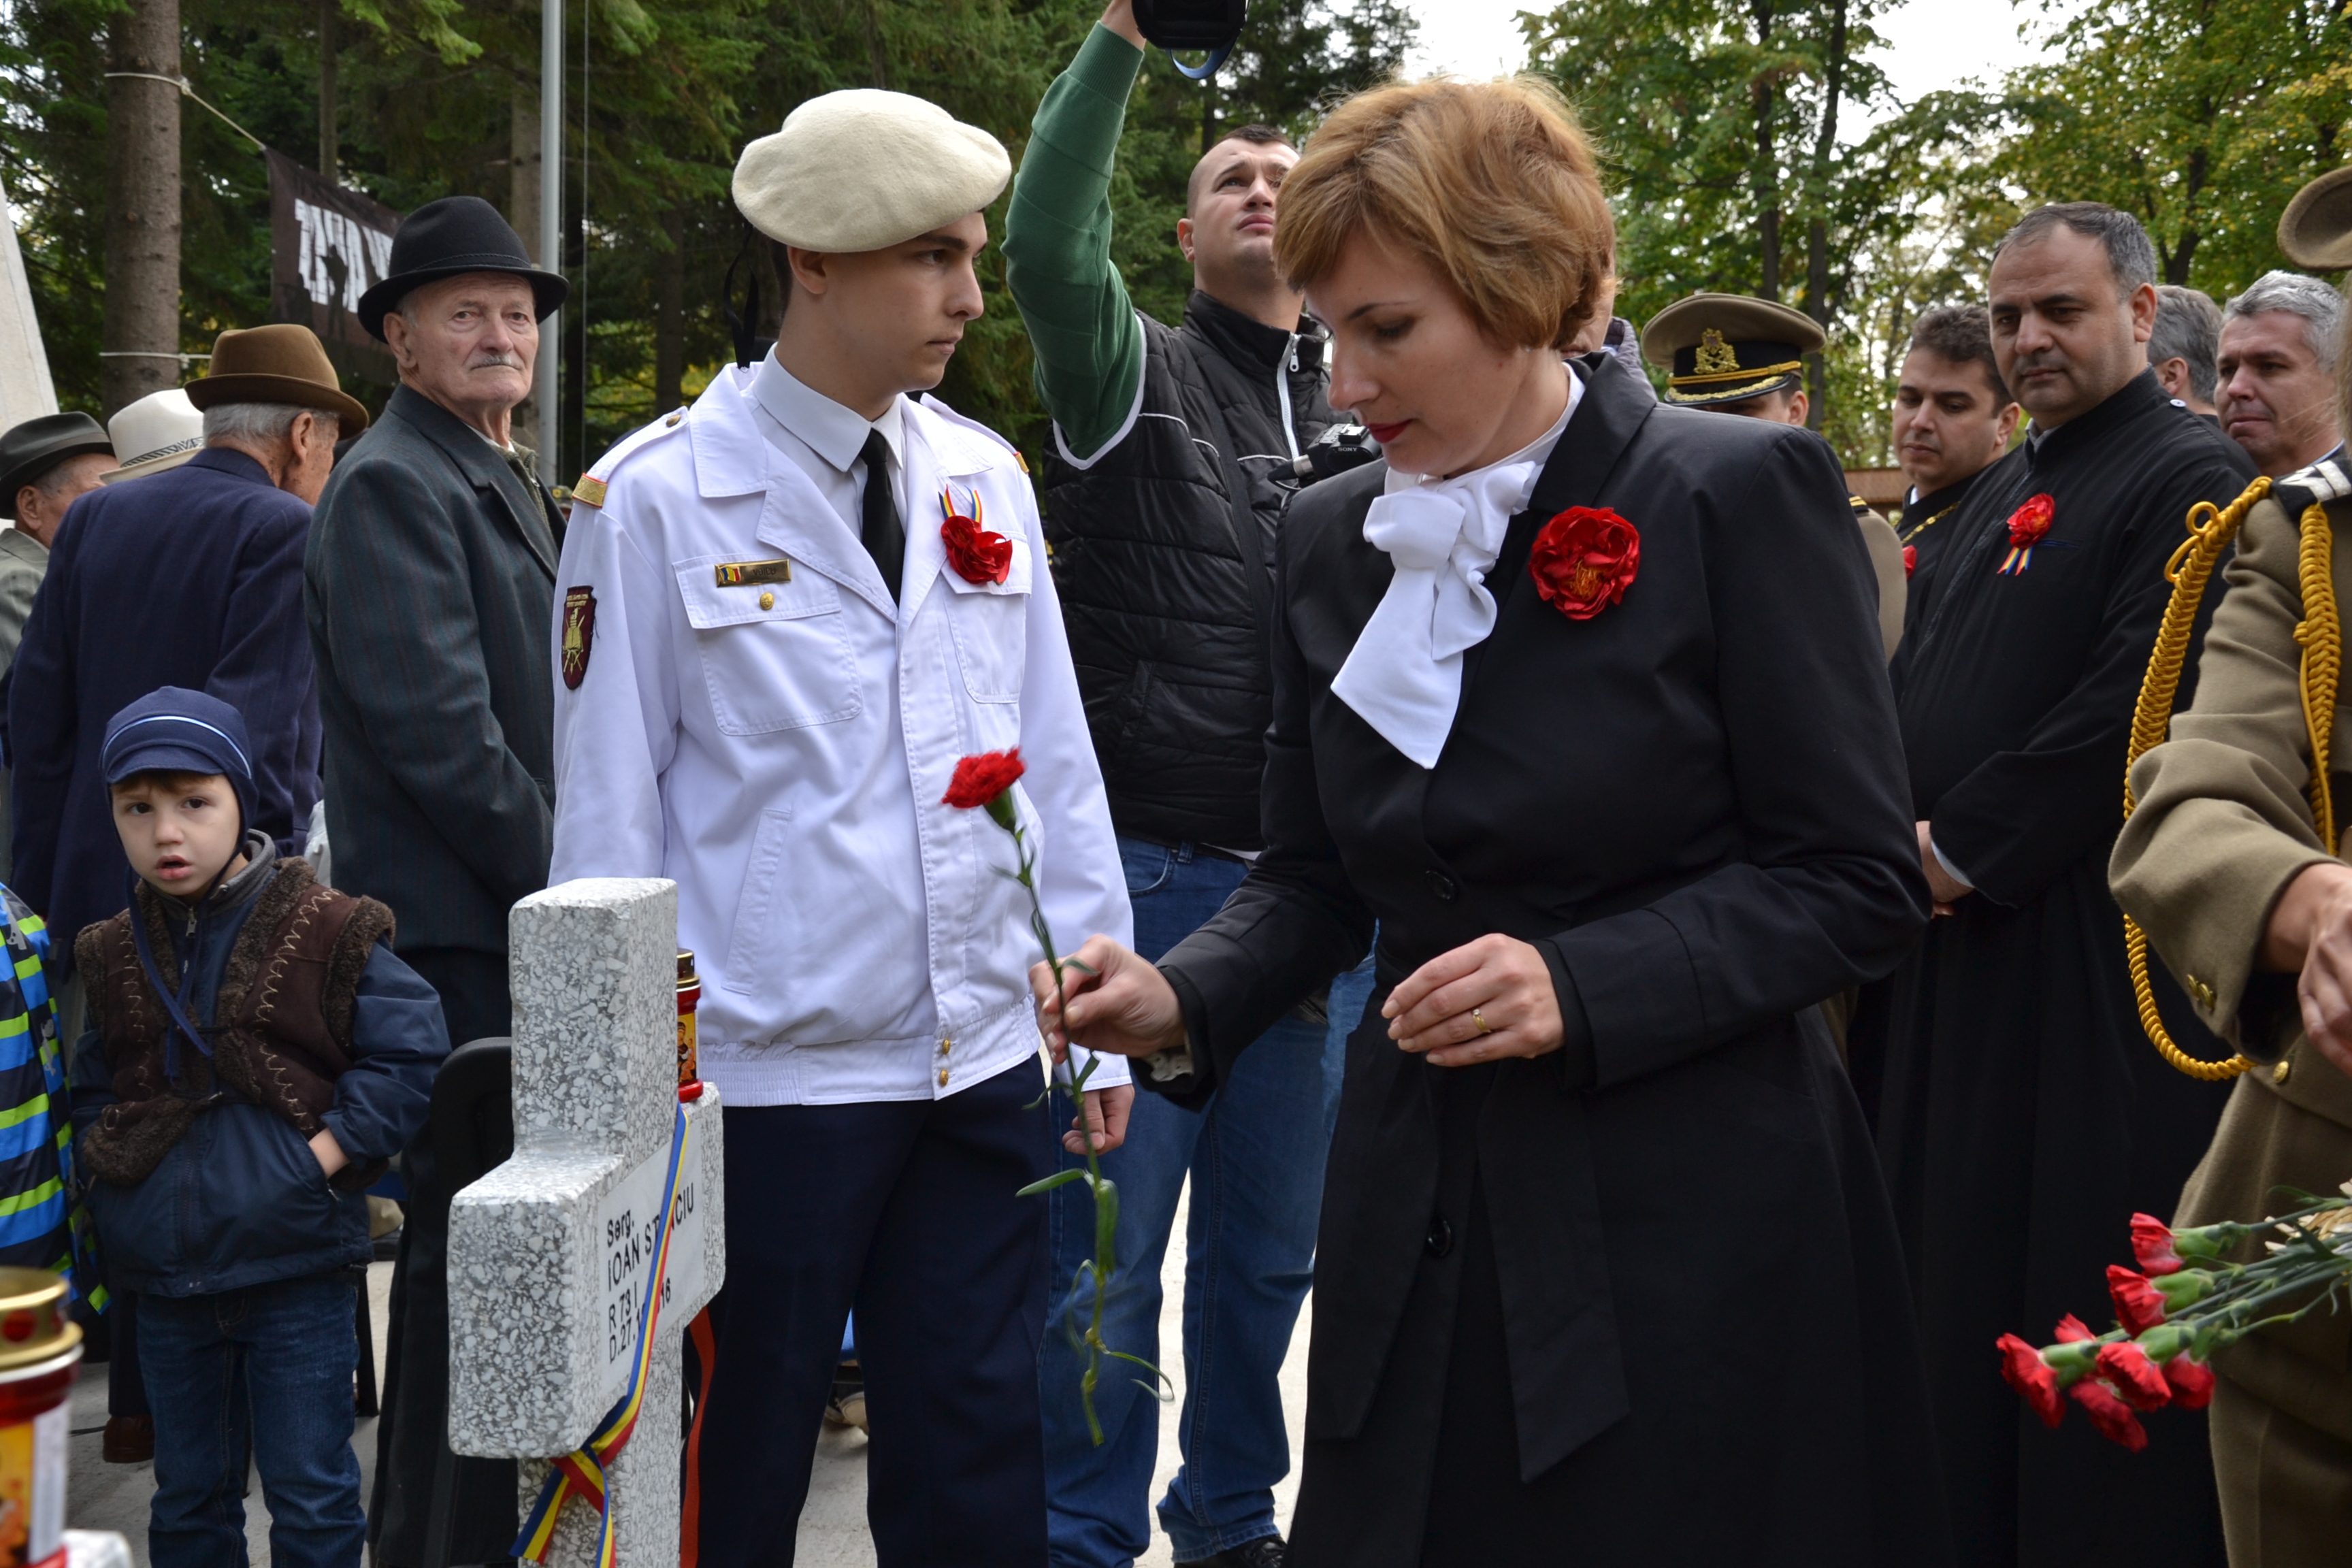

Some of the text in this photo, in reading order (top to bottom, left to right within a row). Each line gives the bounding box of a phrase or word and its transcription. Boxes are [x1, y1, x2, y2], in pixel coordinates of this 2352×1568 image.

[752, 567, 777, 576] VOICU
[607, 1209, 635, 1248] Serg.
[608, 1182, 694, 1292] IOAN STCIU
[608, 1303, 617, 1333] R
[619, 1288, 632, 1322] 73
